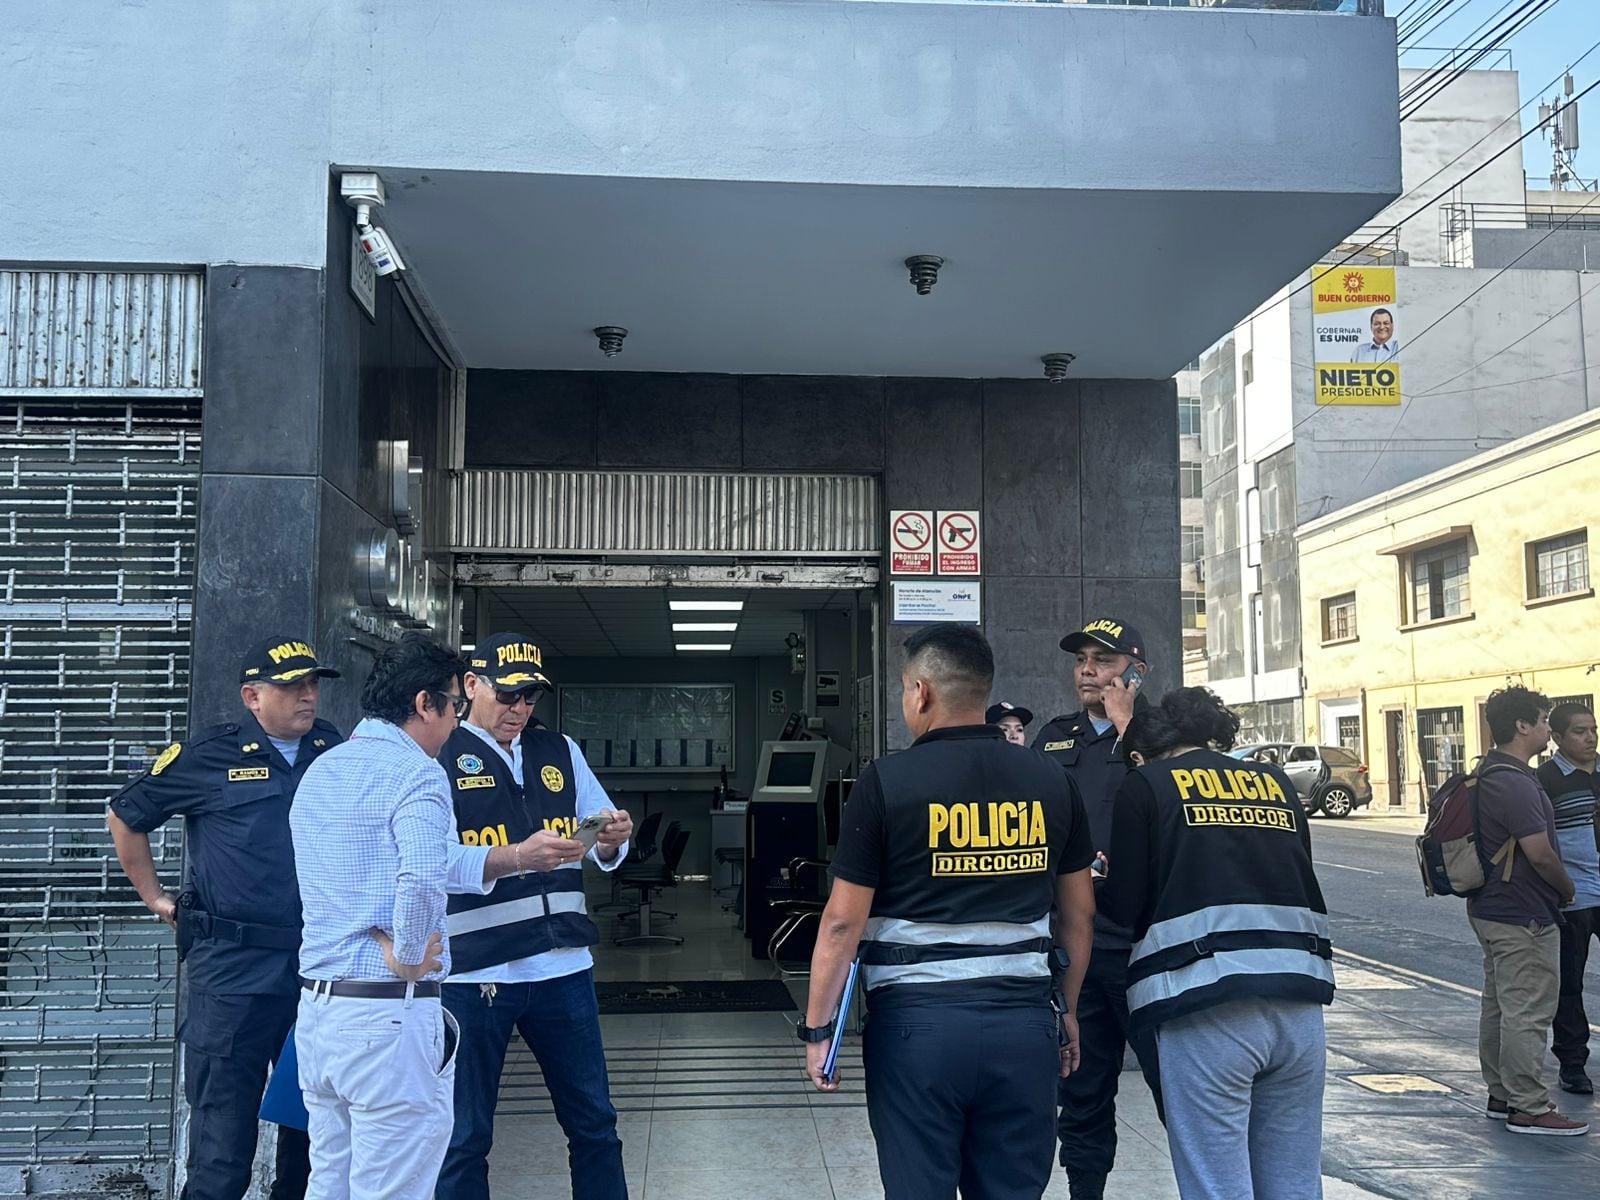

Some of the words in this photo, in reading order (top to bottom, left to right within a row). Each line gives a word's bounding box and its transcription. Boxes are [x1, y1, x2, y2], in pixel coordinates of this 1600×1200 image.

[1318, 294, 1342, 302] BUEN
[1344, 294, 1391, 302] GOBIERNO
[1320, 369, 1395, 387] NIETO
[1321, 387, 1395, 397] PRESIDENTE
[771, 690, 784, 703] S
[1192, 806, 1291, 828] DIRCOCOR
[60, 847, 98, 857] ONPE
[936, 852, 1045, 872] DIRCOCOR
